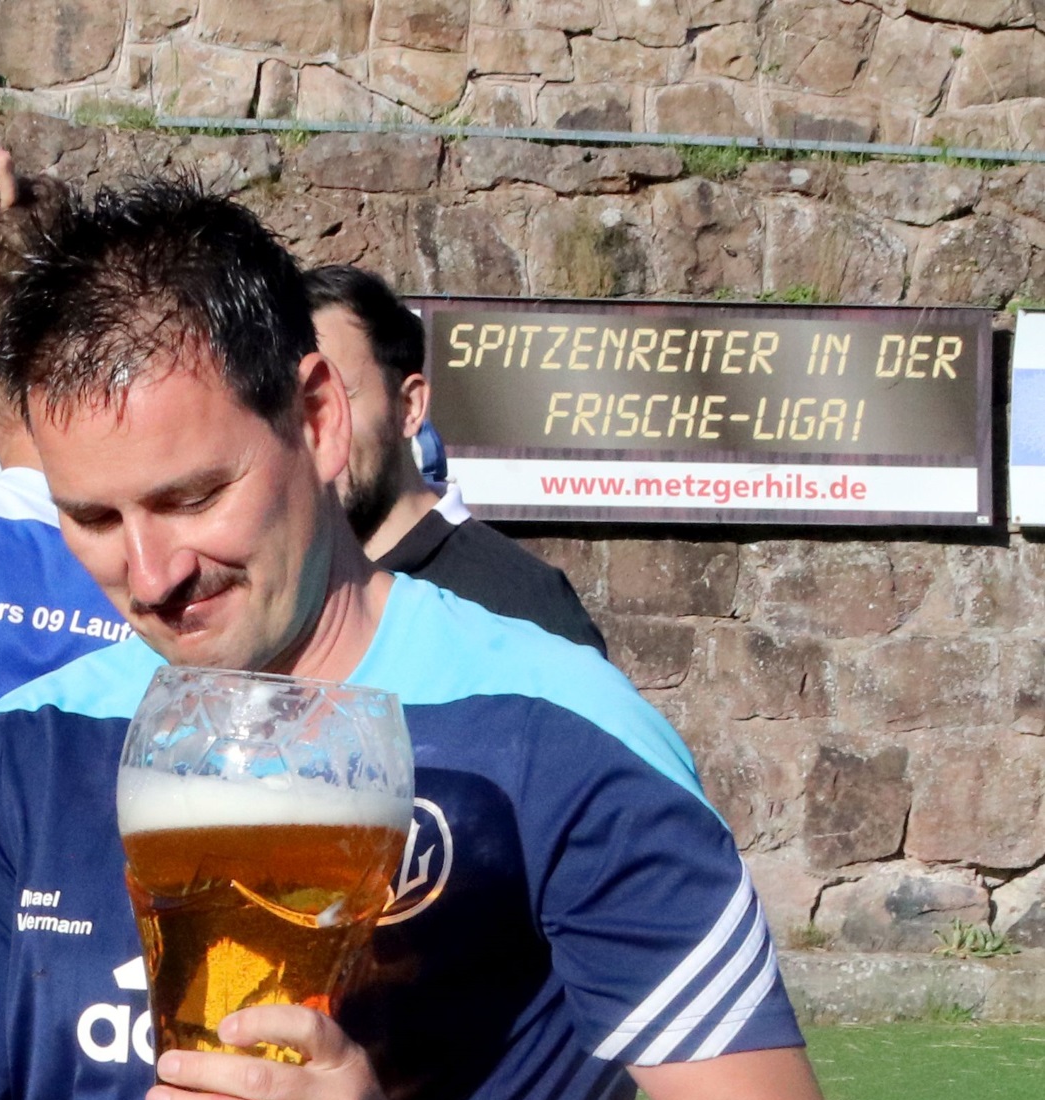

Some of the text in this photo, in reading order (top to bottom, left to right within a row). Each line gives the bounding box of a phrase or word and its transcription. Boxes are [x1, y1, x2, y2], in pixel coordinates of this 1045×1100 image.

[448, 323, 963, 379] SPITZENREITER IN DER
[544, 392, 866, 442] FRISCHE-LIGA!
[540, 473, 868, 503] www.metzgerhils.de
[32, 606, 65, 632] 09
